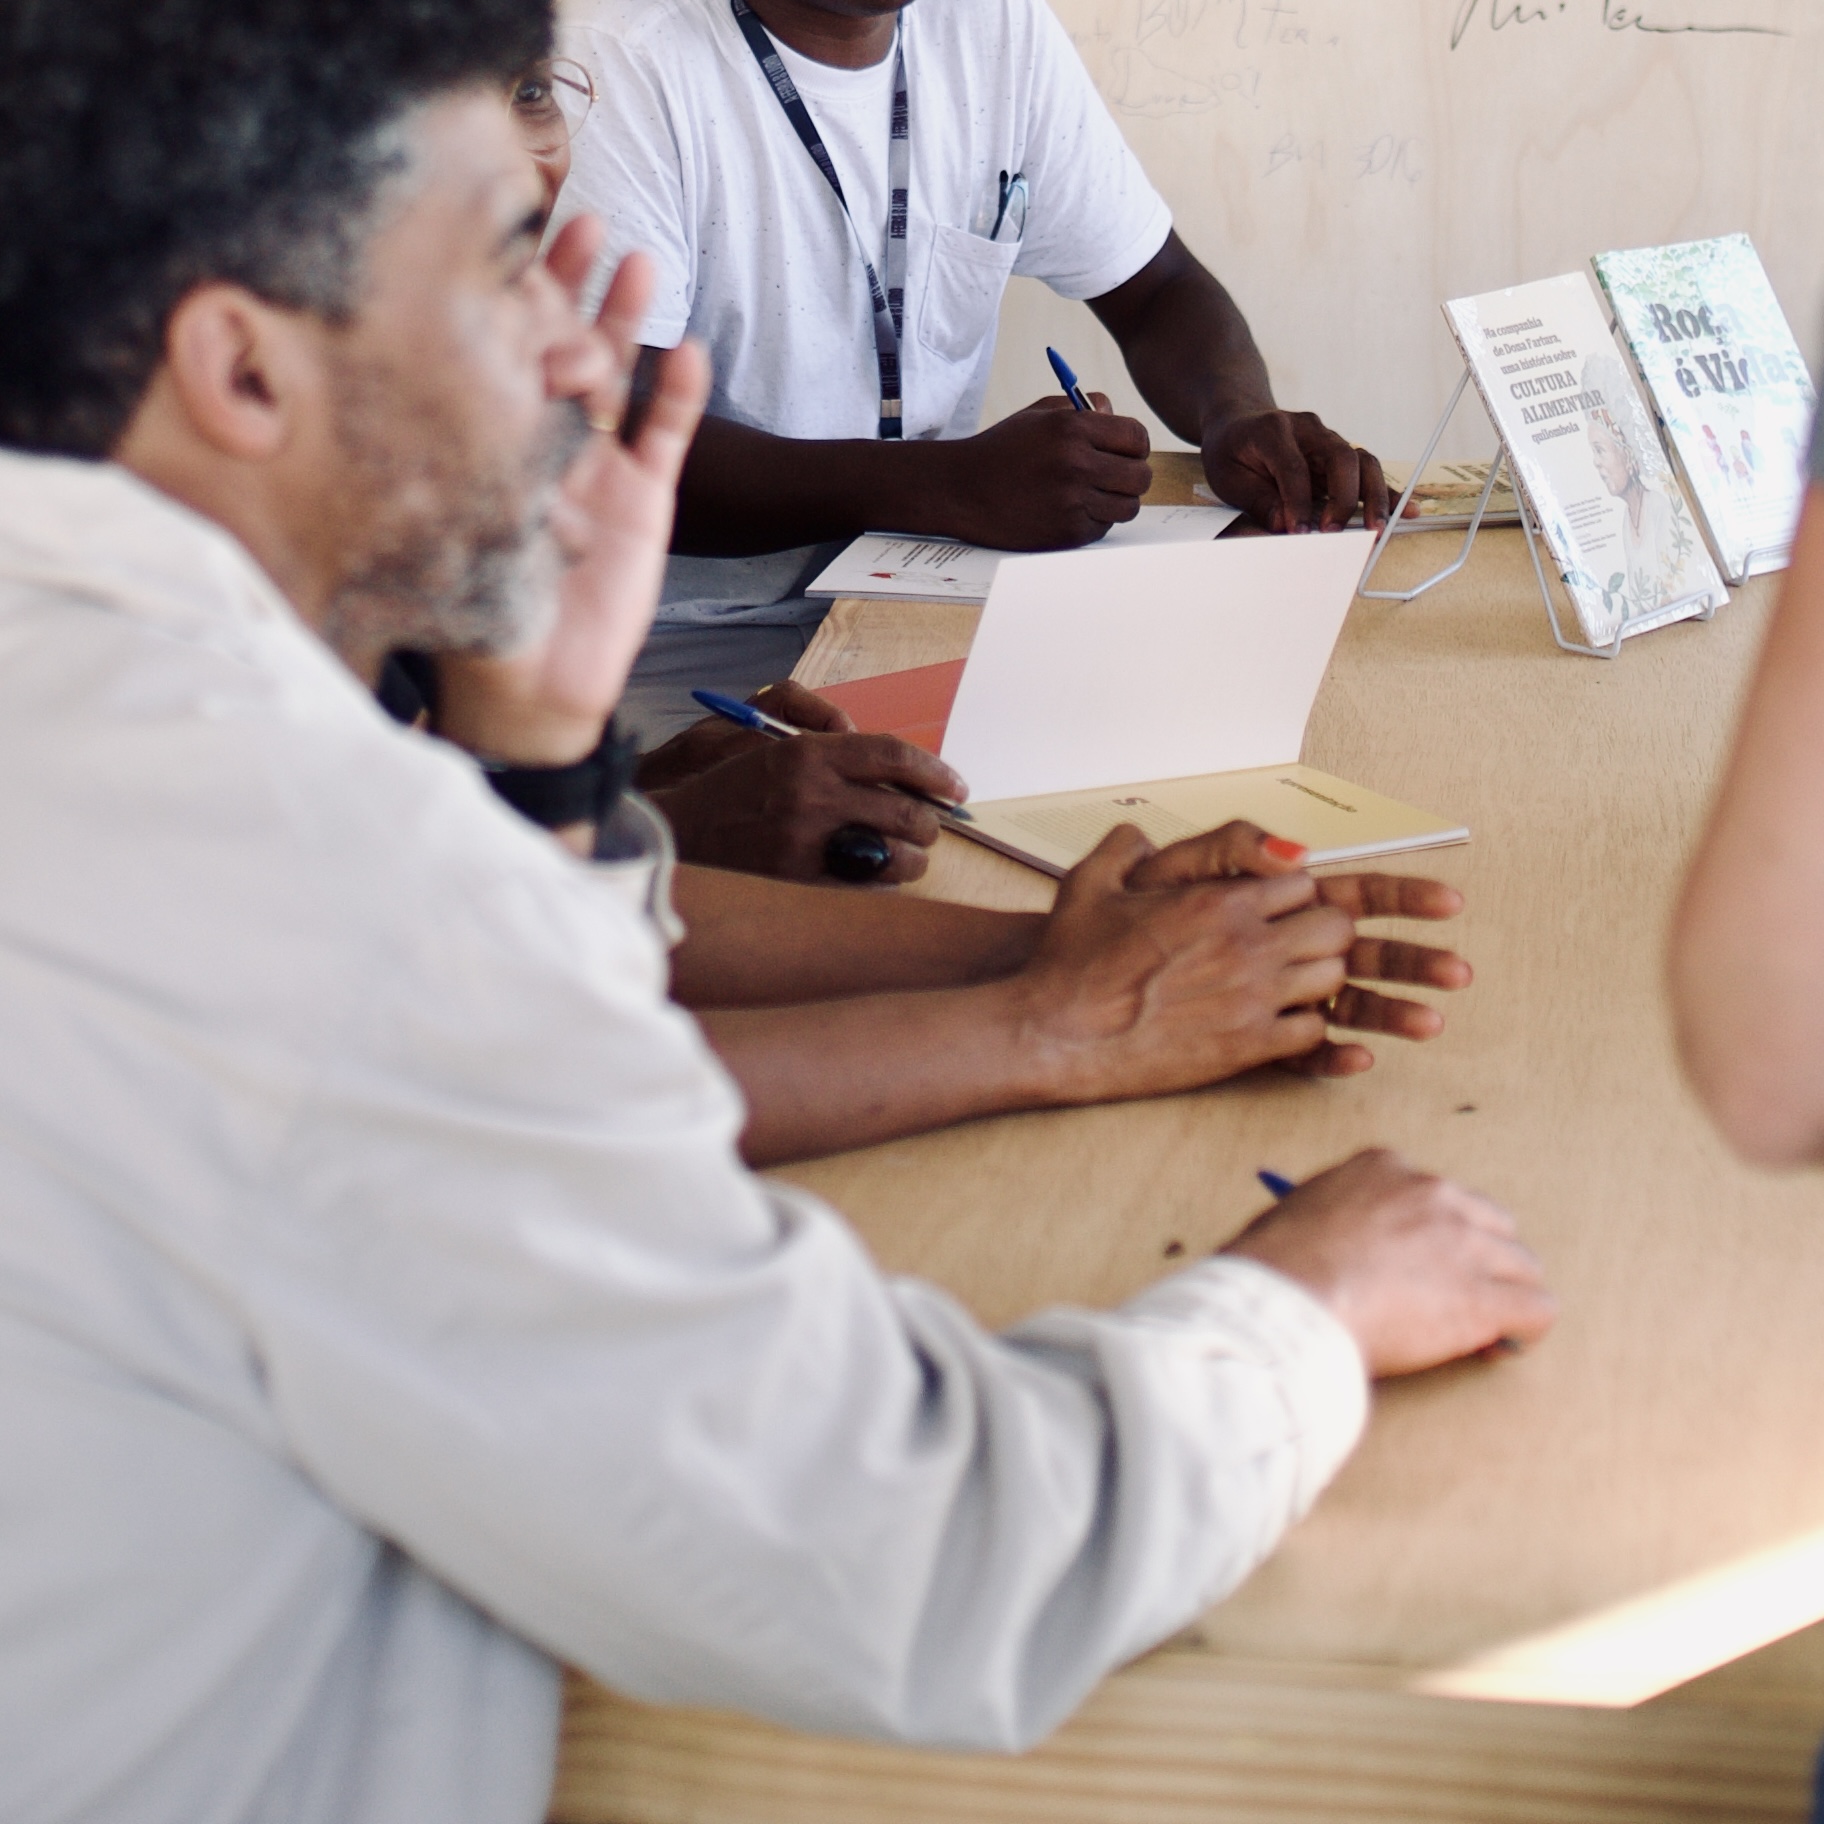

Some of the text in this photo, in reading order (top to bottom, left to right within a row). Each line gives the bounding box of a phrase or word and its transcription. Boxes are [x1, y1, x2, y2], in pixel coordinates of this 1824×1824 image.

[1496, 315, 1544, 342] companhia
[1493, 344, 1505, 358] de
[1500, 347, 1577, 375] uma história sobre
[1509, 369, 1578, 401] CULTURA
[1520, 389, 1606, 426] ALIMENTAR
[1531, 419, 1581, 446] quilombola
